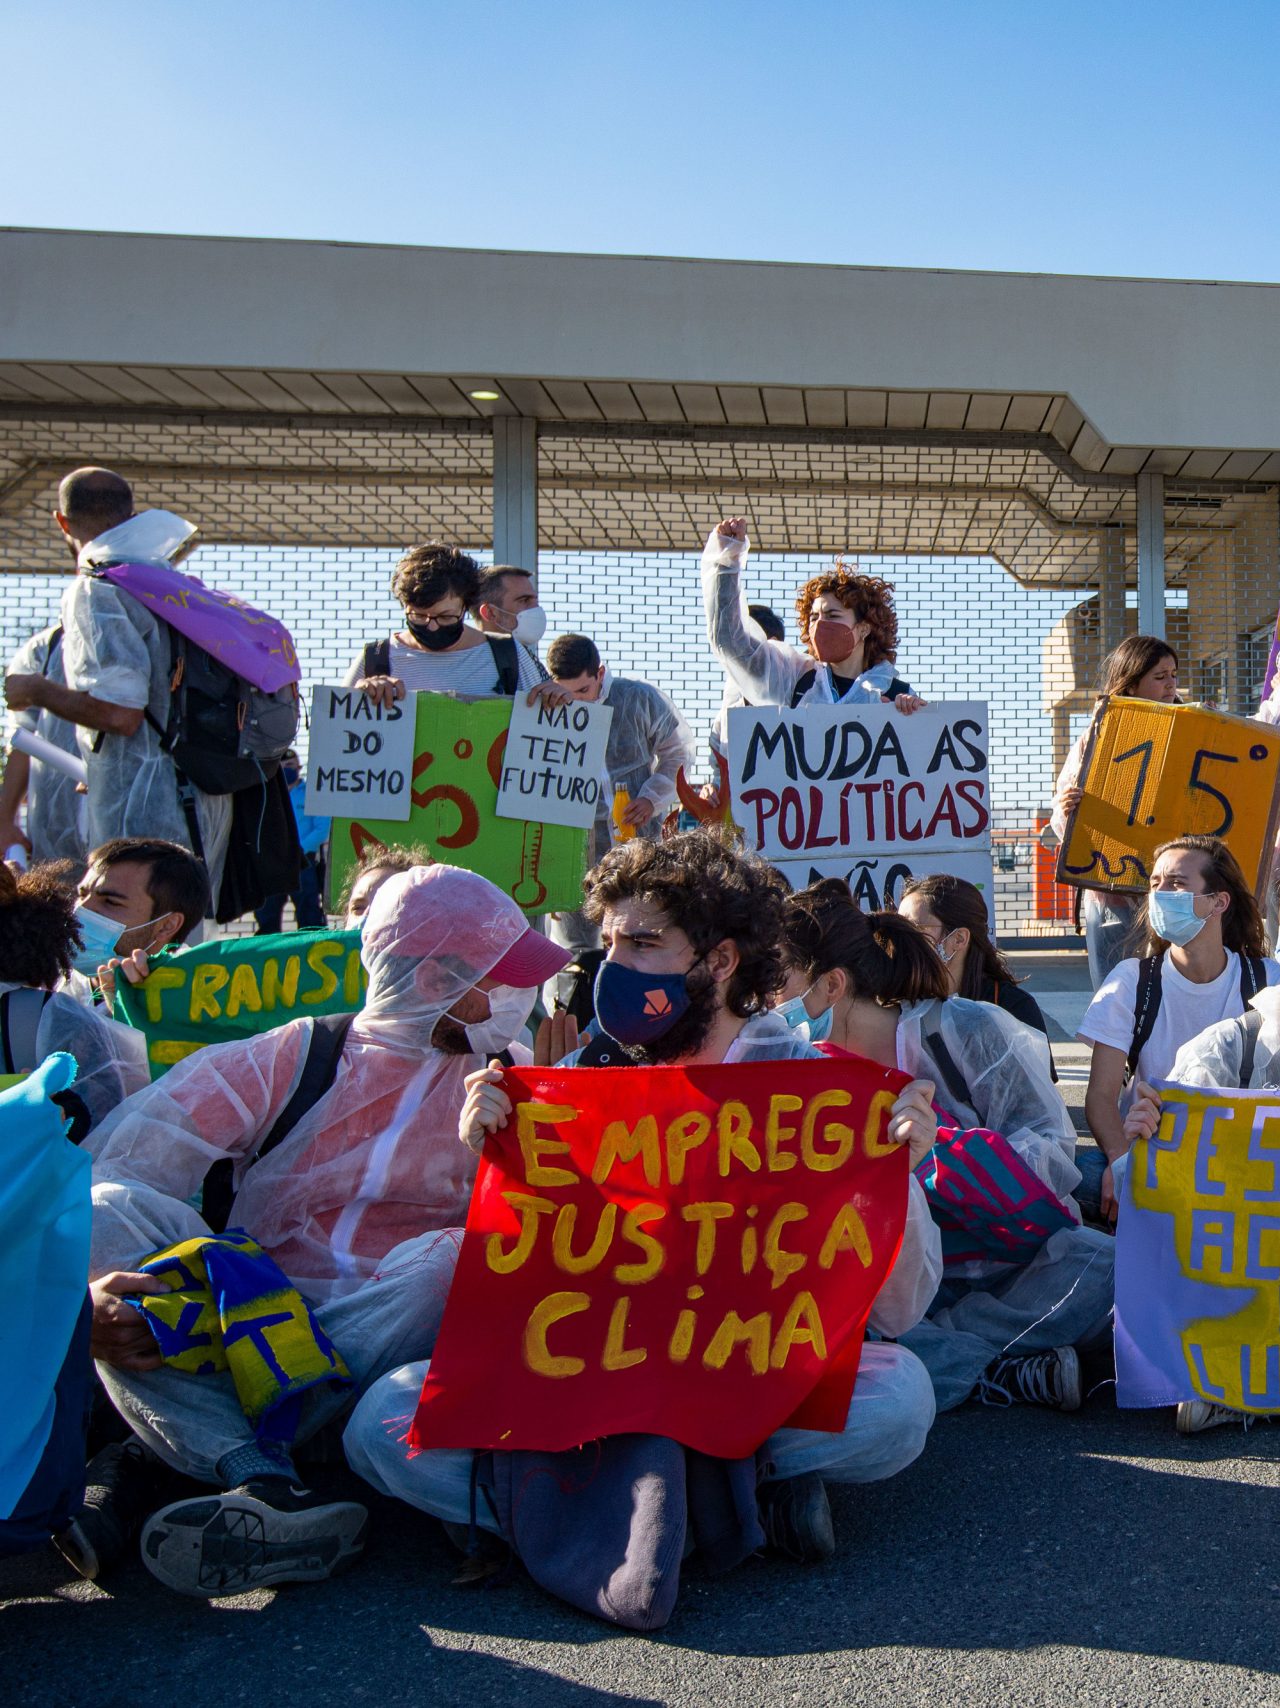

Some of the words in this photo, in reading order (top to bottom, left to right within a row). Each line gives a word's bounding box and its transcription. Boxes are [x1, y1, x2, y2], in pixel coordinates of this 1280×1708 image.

[343, 730, 385, 755] DO
[521, 734, 587, 767] TEM
[742, 721, 910, 783] MUDA
[926, 719, 987, 773] AS
[316, 766, 404, 795] MESMO
[516, 1089, 901, 1188] EMPREGO
